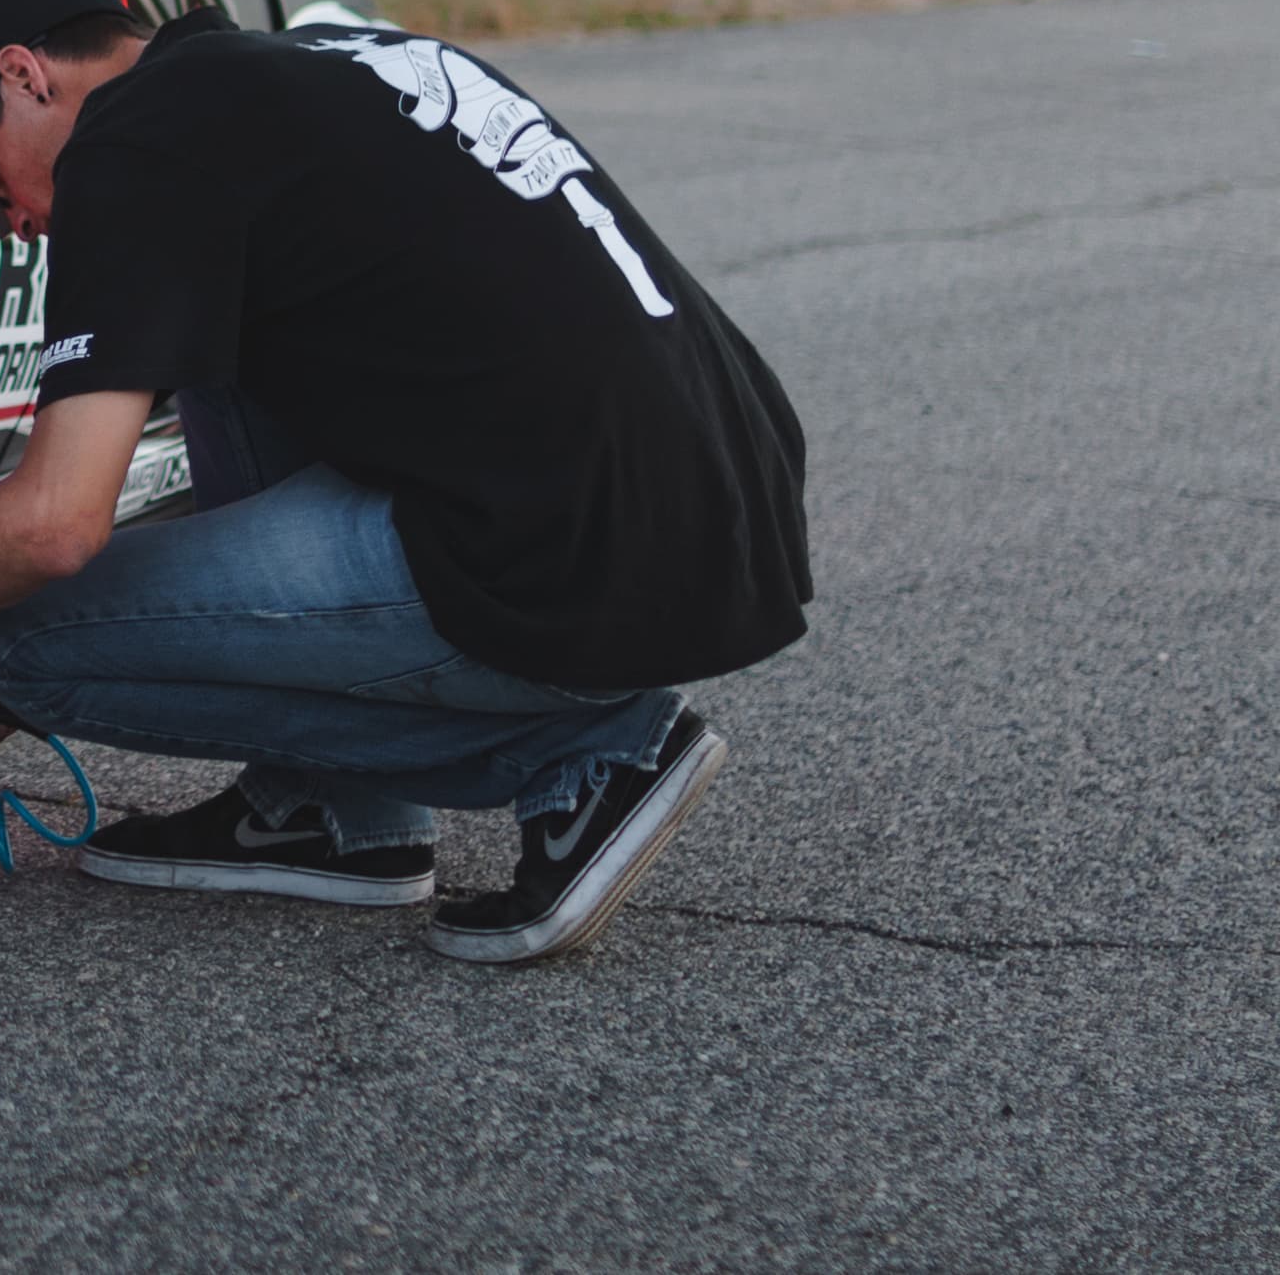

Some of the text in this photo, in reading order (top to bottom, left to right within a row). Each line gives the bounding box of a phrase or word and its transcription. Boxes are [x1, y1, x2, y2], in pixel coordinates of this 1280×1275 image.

[483, 101, 522, 152] SHOW IT
[522, 146, 576, 192] TRACK IT
